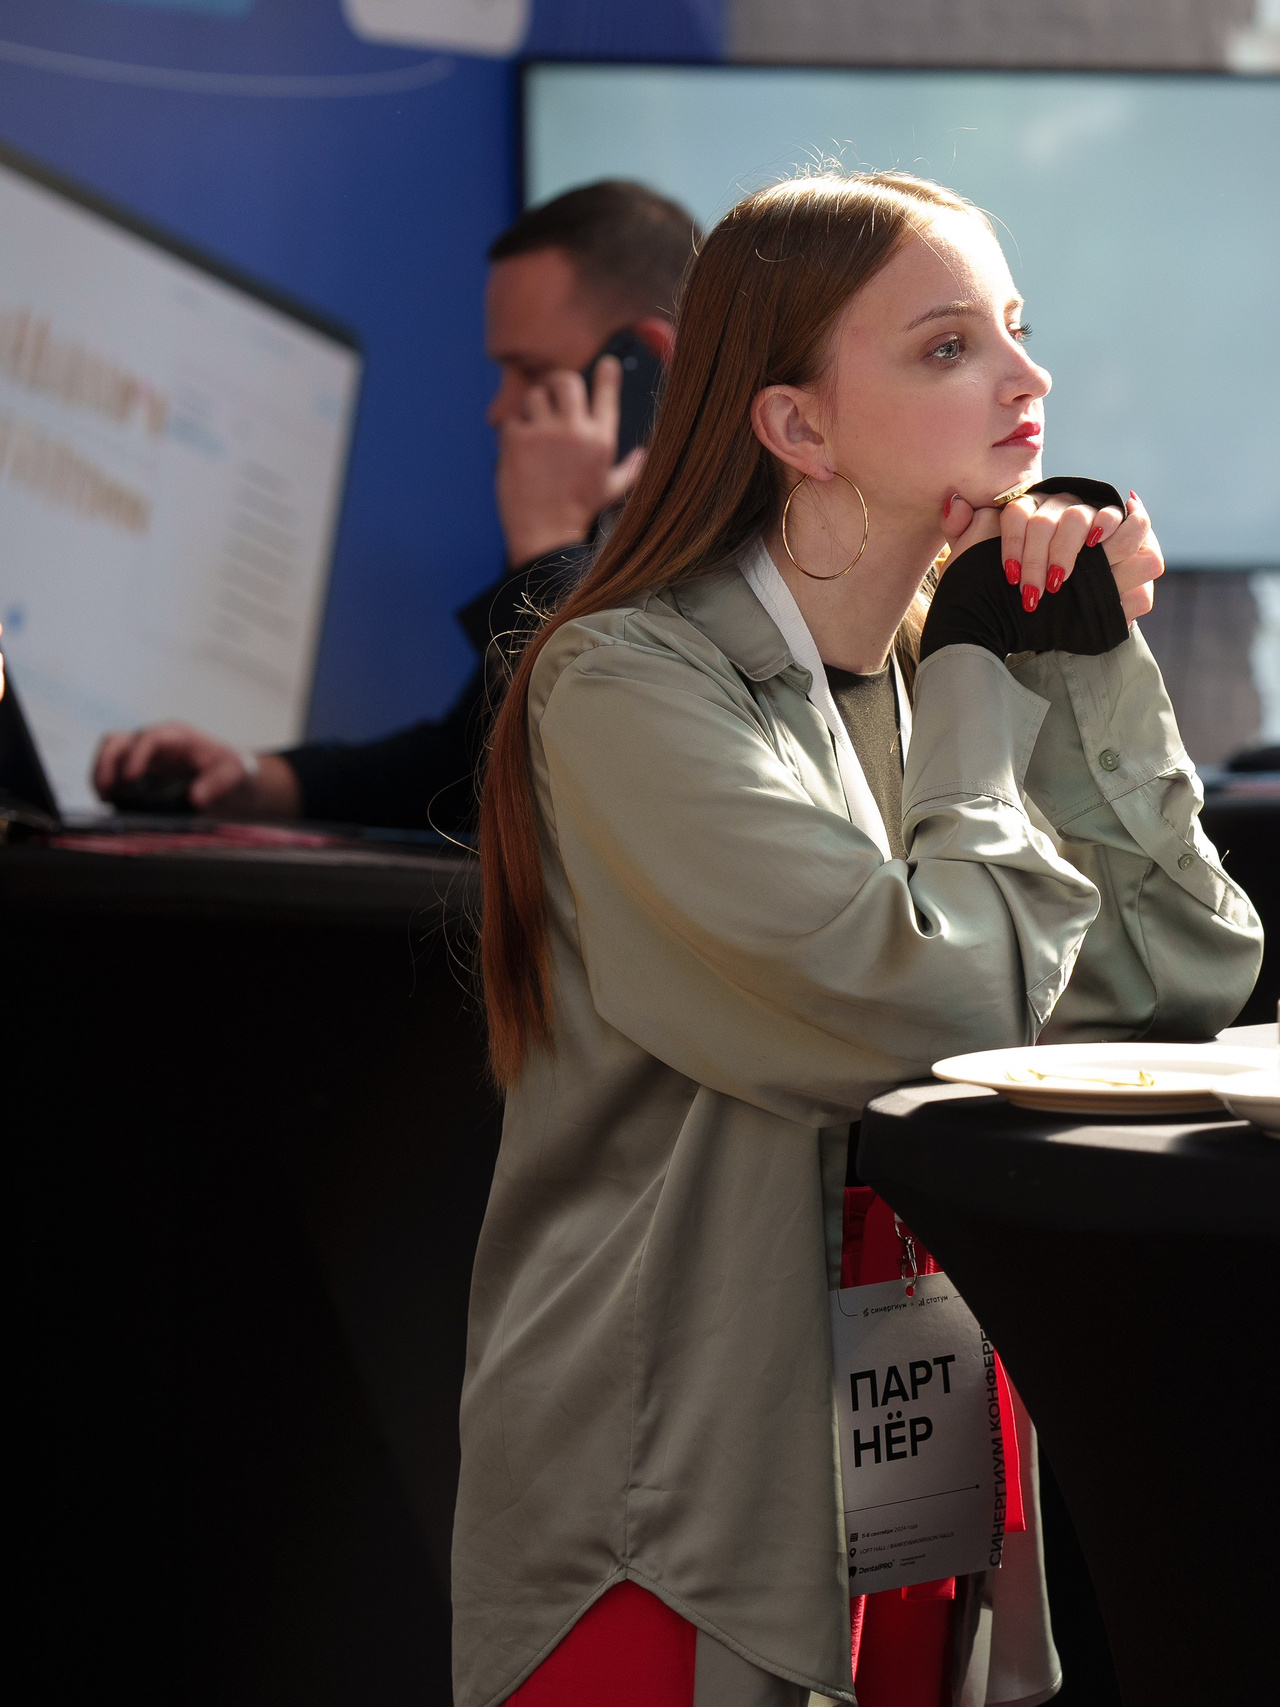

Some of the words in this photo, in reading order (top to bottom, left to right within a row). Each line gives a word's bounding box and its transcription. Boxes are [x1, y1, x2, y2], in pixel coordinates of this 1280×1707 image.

[871, 1303, 907, 1314] синергиум
[927, 1295, 949, 1305] статум
[850, 1354, 956, 1412] ПАРТ
[853, 1410, 934, 1468] НЁР
[989, 1438, 1006, 1567] СИНЕРГИУМ
[871, 1529, 893, 1537] сентября
[939, 1531, 954, 1539] HALLS
